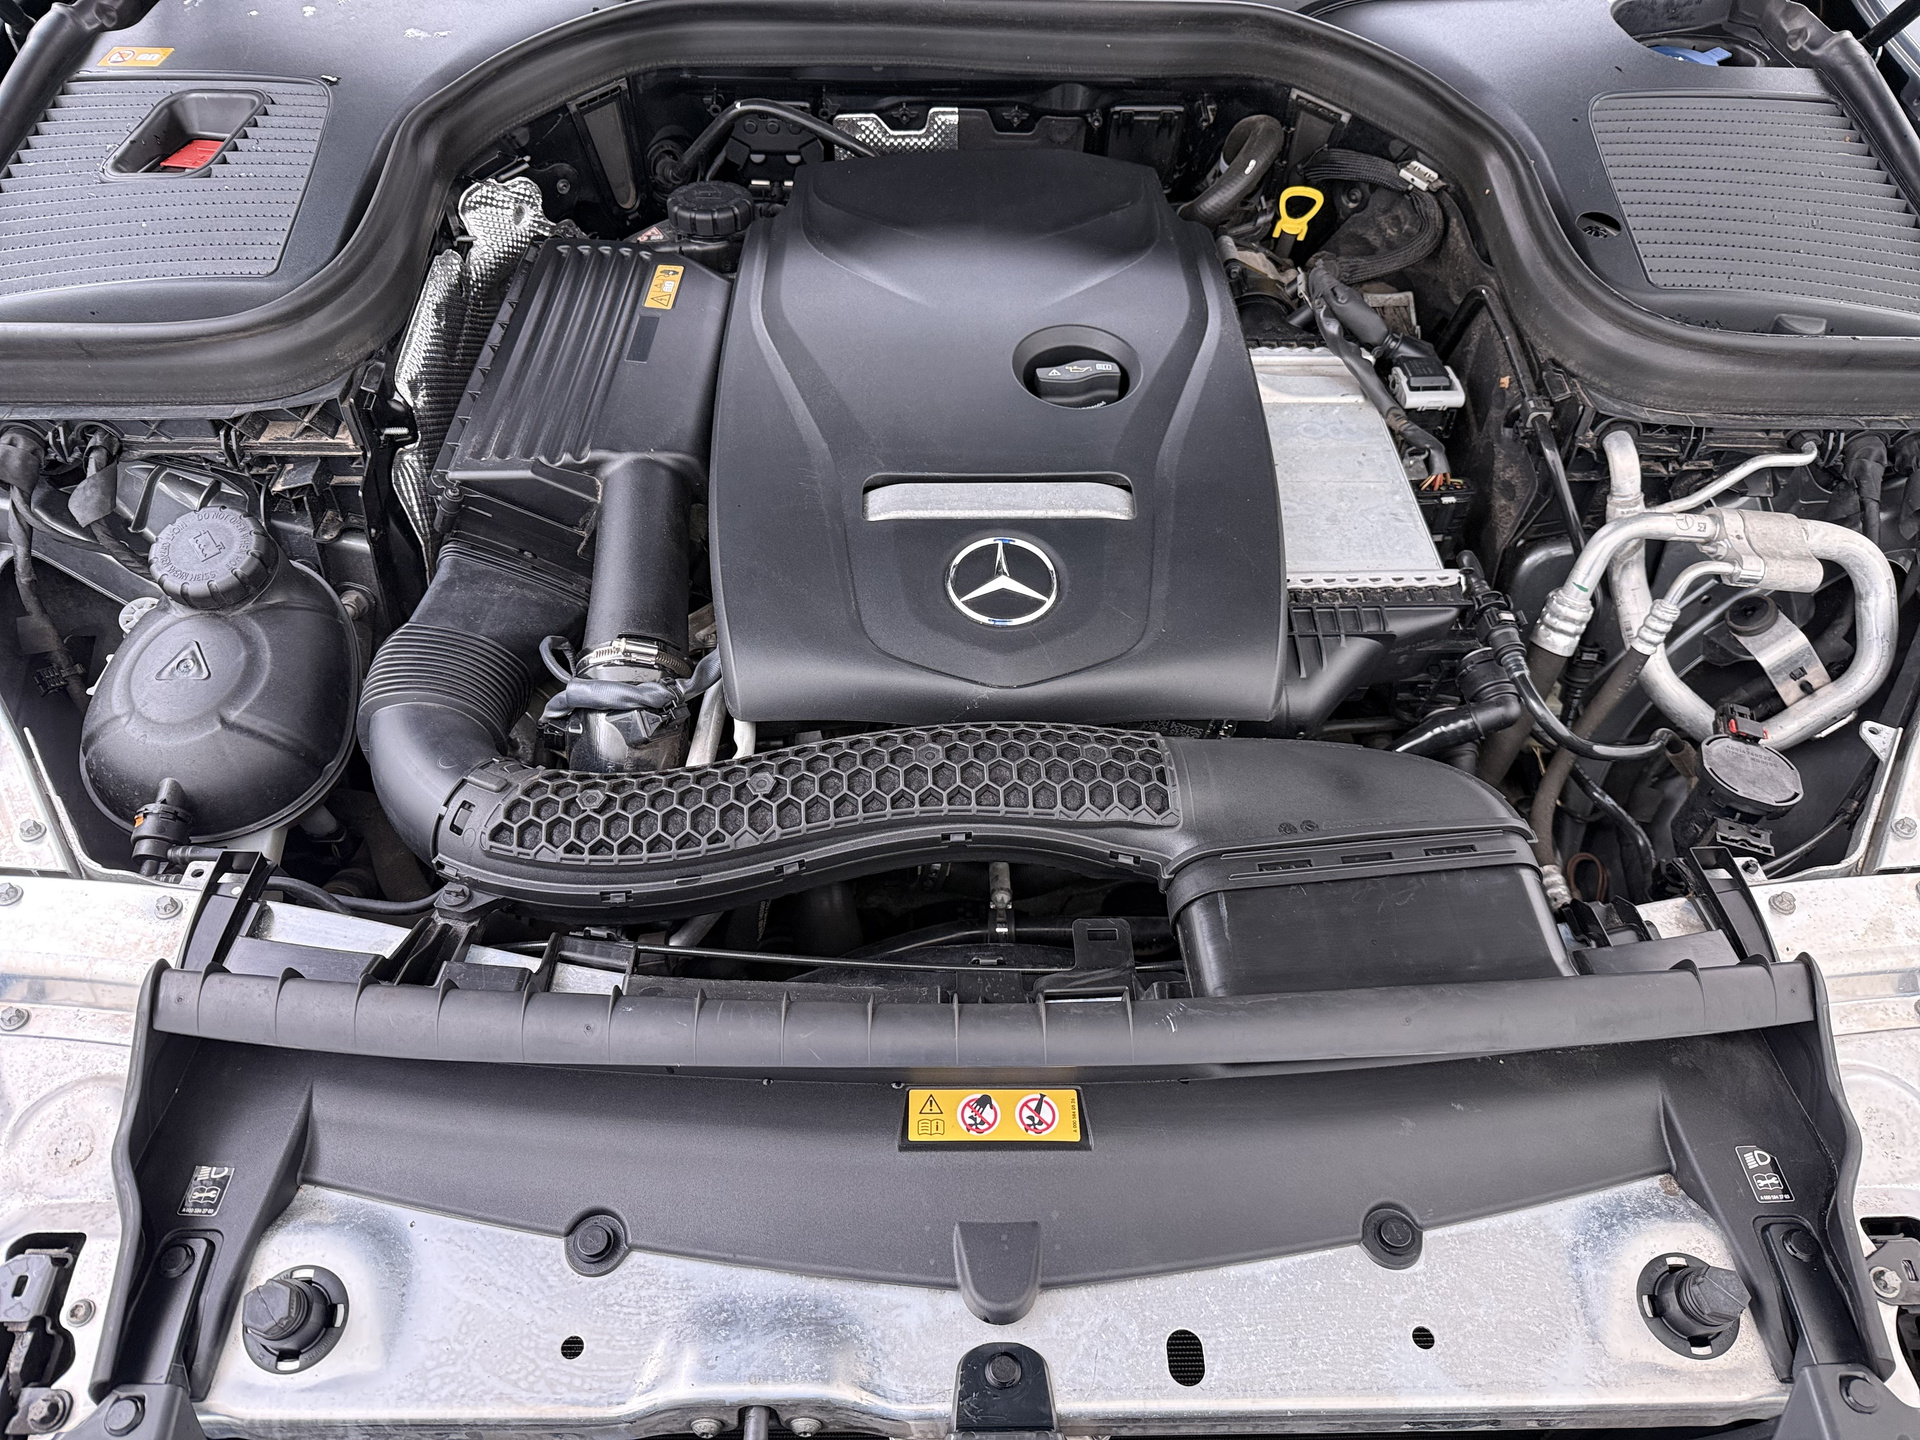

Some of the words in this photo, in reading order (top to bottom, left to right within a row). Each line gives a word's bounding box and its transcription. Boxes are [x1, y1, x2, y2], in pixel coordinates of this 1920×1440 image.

[197, 511, 210, 521] DO
[212, 510, 230, 520] NOT
[230, 517, 247, 533] OPEN
[190, 571, 216, 581] HEISS
